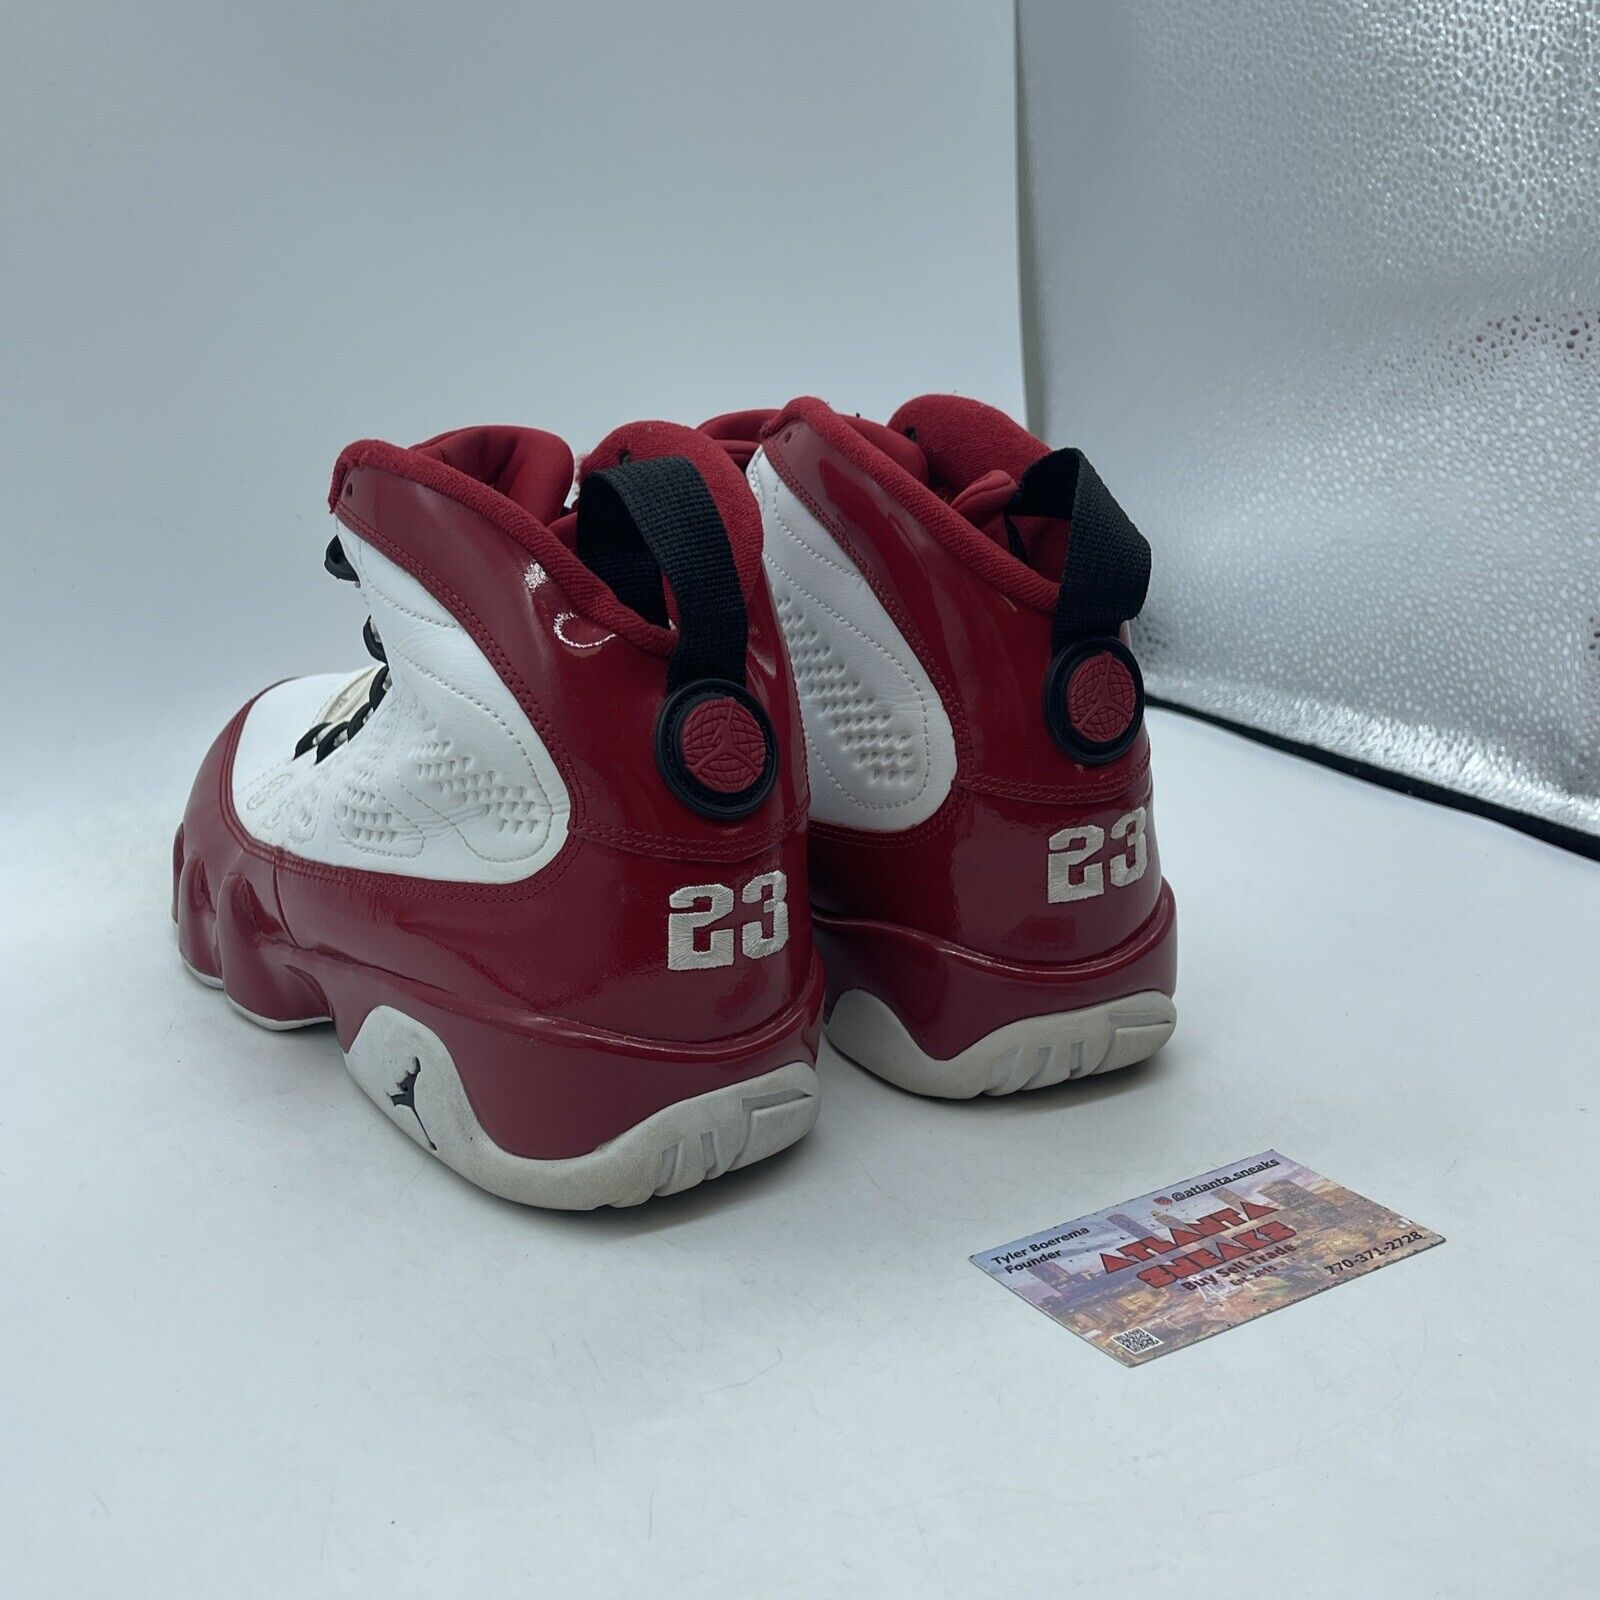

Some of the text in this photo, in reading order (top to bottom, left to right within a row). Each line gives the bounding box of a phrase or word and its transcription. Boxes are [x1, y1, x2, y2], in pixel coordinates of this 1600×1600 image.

[1047, 806, 1148, 904] 23
[667, 870, 789, 971] 23
[1171, 1158, 1281, 1202] @atlanta.sneaks
[991, 1227, 1090, 1266] Tyler Boerema
[1099, 1201, 1279, 1274] ATLANTA
[1136, 1220, 1297, 1288] SNEAKS
[1324, 1231, 1423, 1275] 770-371-2728
[1004, 1249, 1062, 1275] Founder
[1181, 1244, 1298, 1292] Buy Sell Trade
